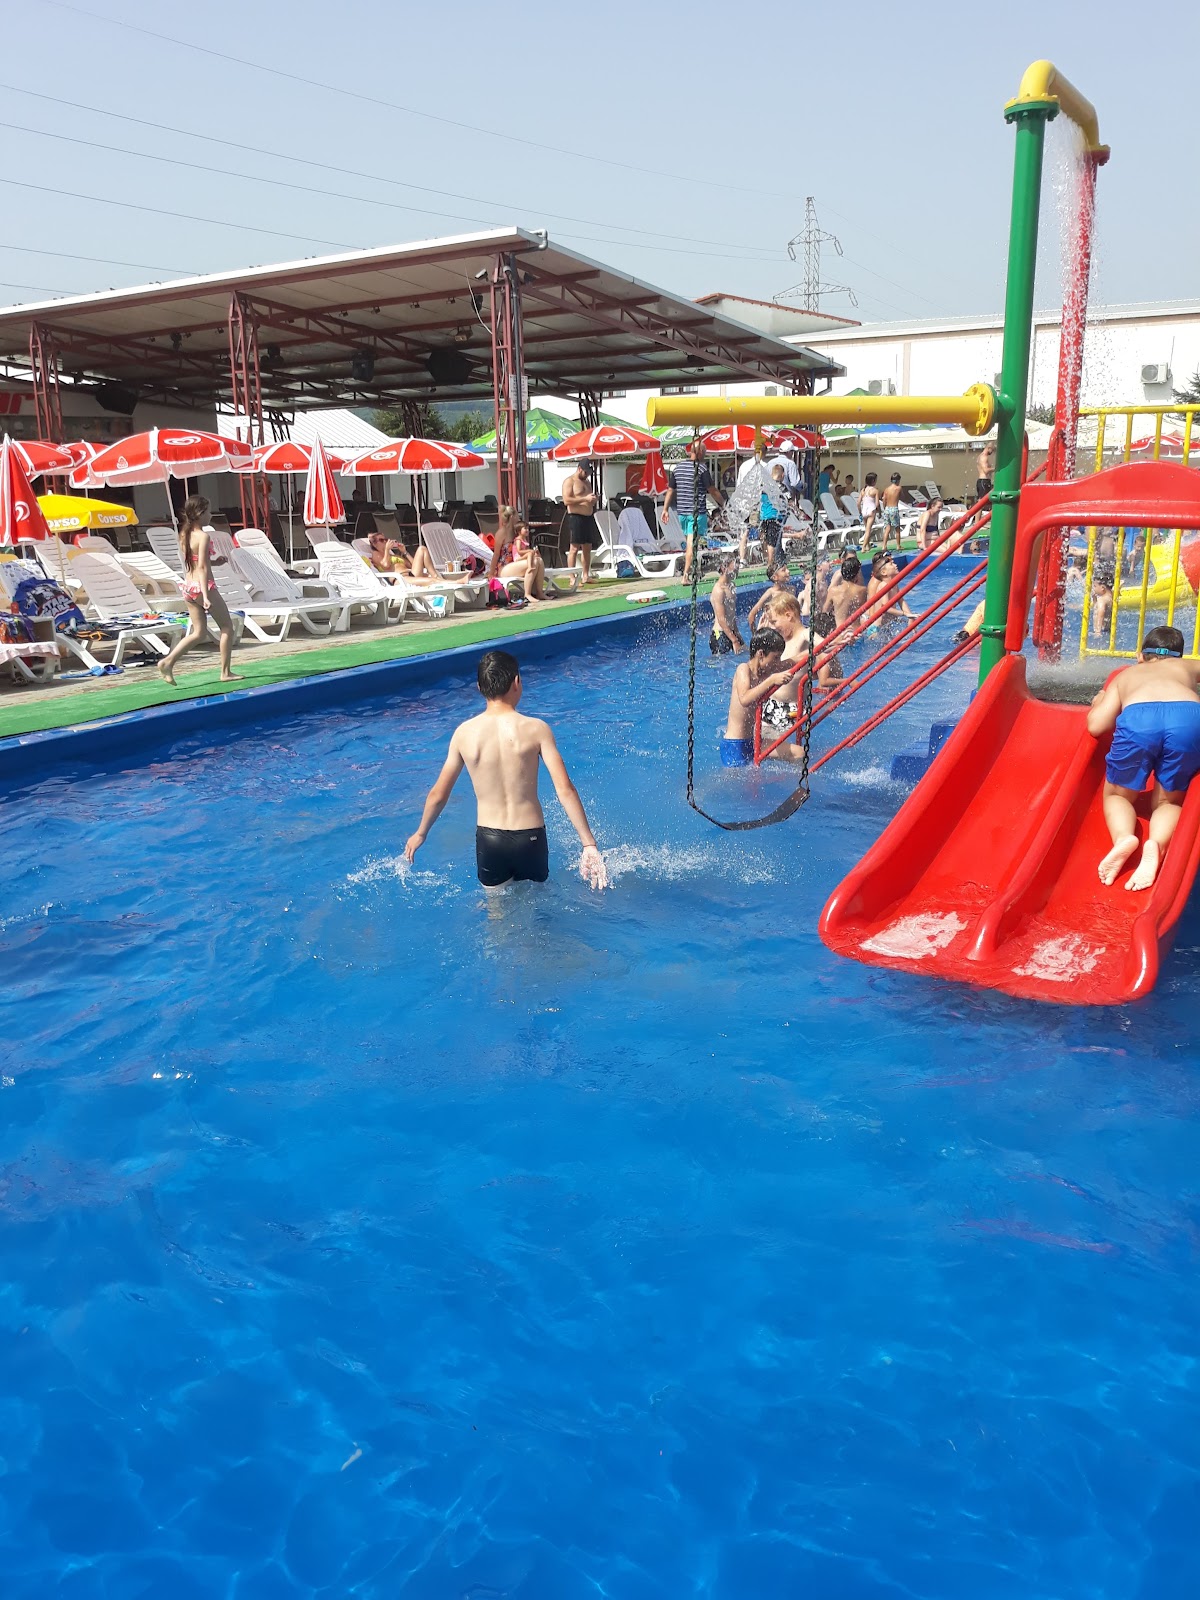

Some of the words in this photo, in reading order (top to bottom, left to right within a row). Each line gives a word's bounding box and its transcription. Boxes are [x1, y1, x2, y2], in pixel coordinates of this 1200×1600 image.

[46, 516, 80, 529] orso
[97, 513, 128, 524] Corso
[42, 594, 73, 611] STAR
[40, 603, 71, 618] WARS
